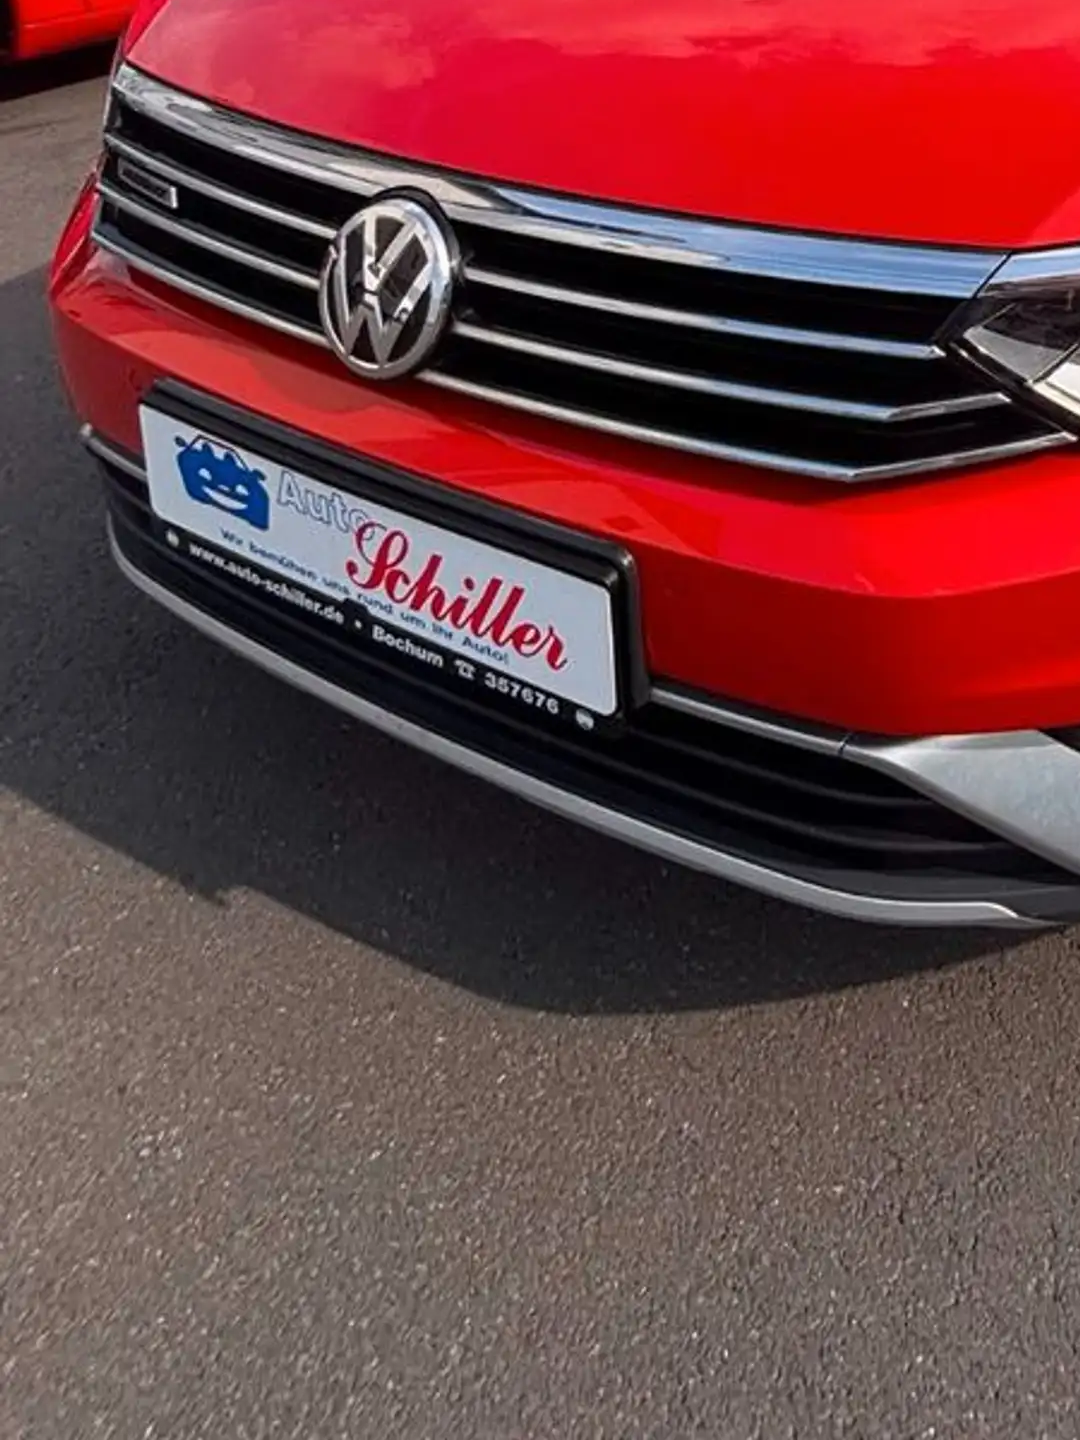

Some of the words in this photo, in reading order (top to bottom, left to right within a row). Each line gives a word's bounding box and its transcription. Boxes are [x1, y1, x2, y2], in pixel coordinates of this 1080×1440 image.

[277, 470, 375, 542] Auto
[189, 542, 345, 624] www.auto-schiller.de
[371, 625, 444, 669] Bochum
[485, 672, 560, 714] 357676
[220, 527, 243, 545] Wir
[322, 576, 350, 596] uns
[357, 593, 393, 615] rund
[400, 612, 427, 630] um
[431, 623, 453, 640] Ihr
[462, 636, 510, 665] Auto!
[346, 521, 567, 671] Schiller
